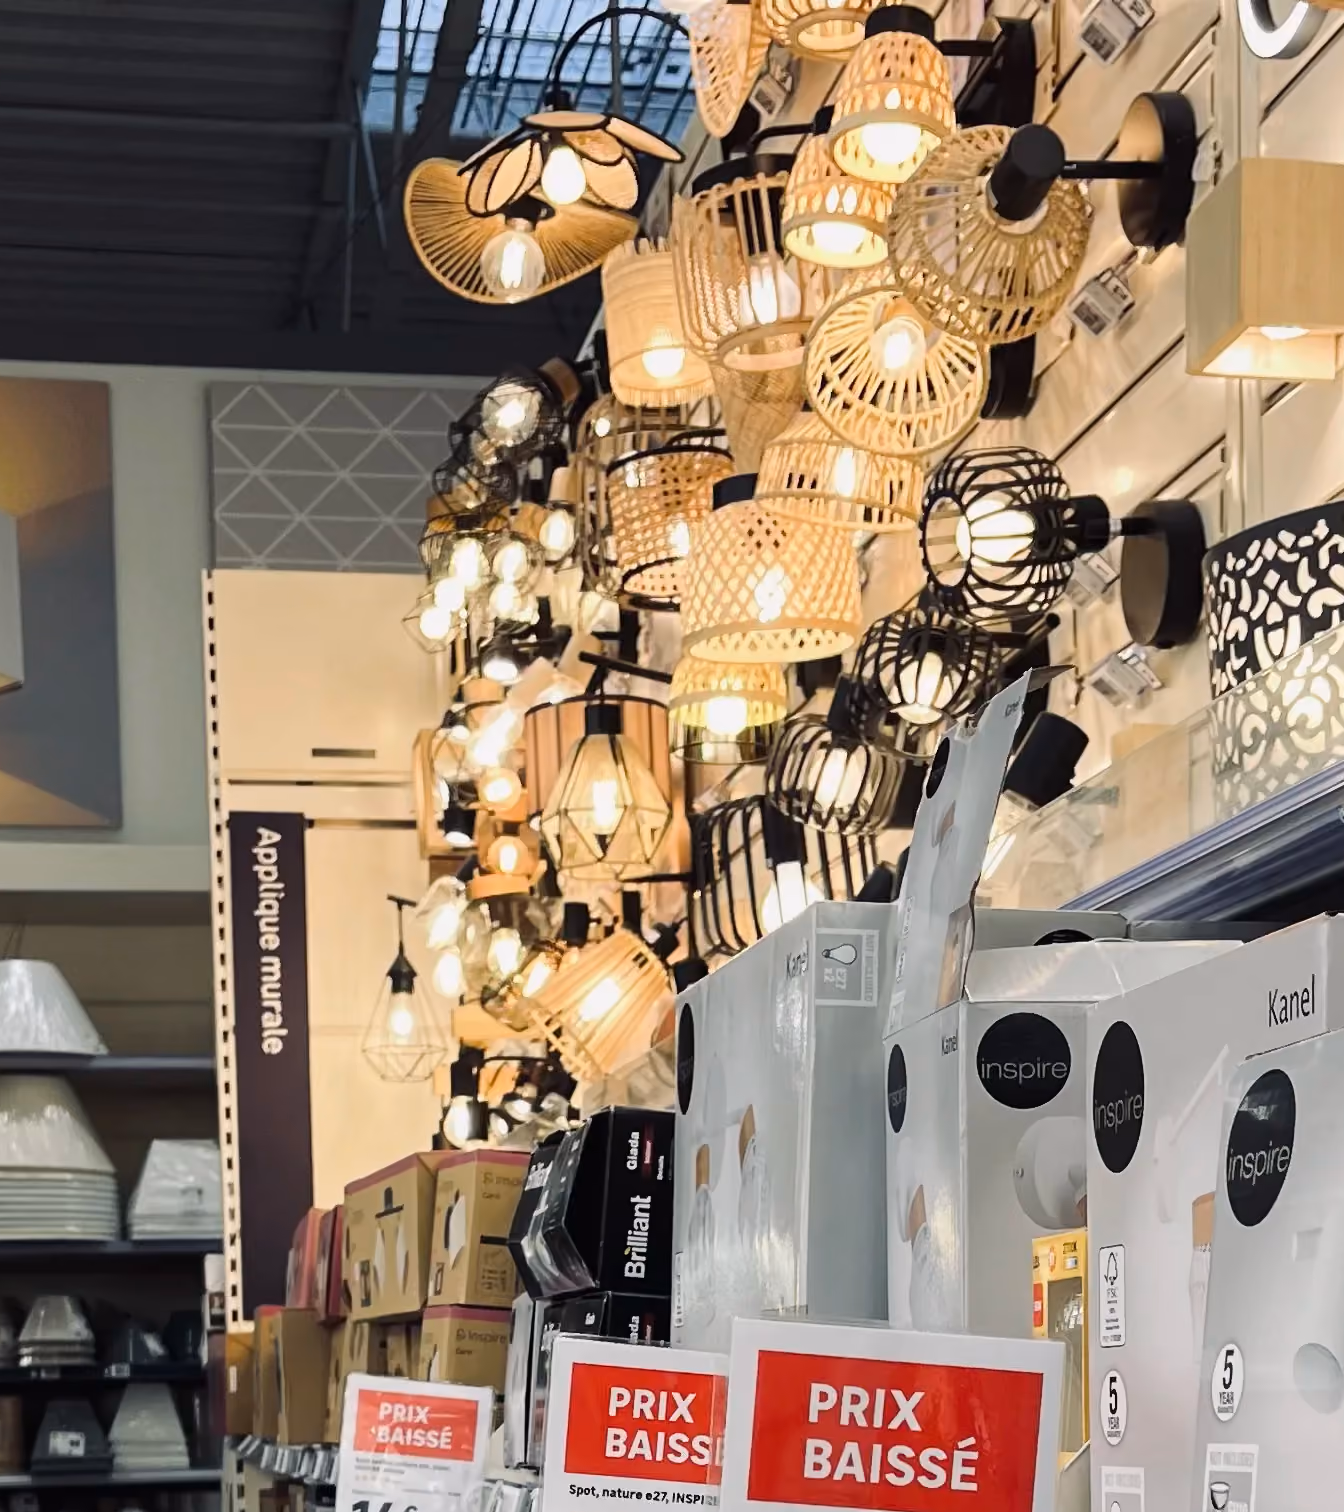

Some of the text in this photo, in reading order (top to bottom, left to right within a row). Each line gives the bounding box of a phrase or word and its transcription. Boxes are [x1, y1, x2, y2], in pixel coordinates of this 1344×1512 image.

[251, 826, 289, 1055] Applique murale
[1268, 974, 1315, 1027] Kanel
[980, 1057, 1068, 1085] inspire
[1094, 1089, 1144, 1133] inspire
[1227, 1141, 1291, 1187] inspire
[624, 1195, 652, 1279] Brilliant
[1222, 1349, 1235, 1390] 5
[379, 1402, 430, 1424] PRIX
[608, 1386, 697, 1424] PRIX
[808, 1382, 926, 1432] PRIX
[1109, 1376, 1118, 1415] 5
[376, 1425, 452, 1450] BAISSÉ
[803, 1436, 980, 1492] BAISSÉ
[569, 1484, 599, 1498] Spot,
[603, 1488, 643, 1500] nature
[646, 1491, 669, 1504] e27,
